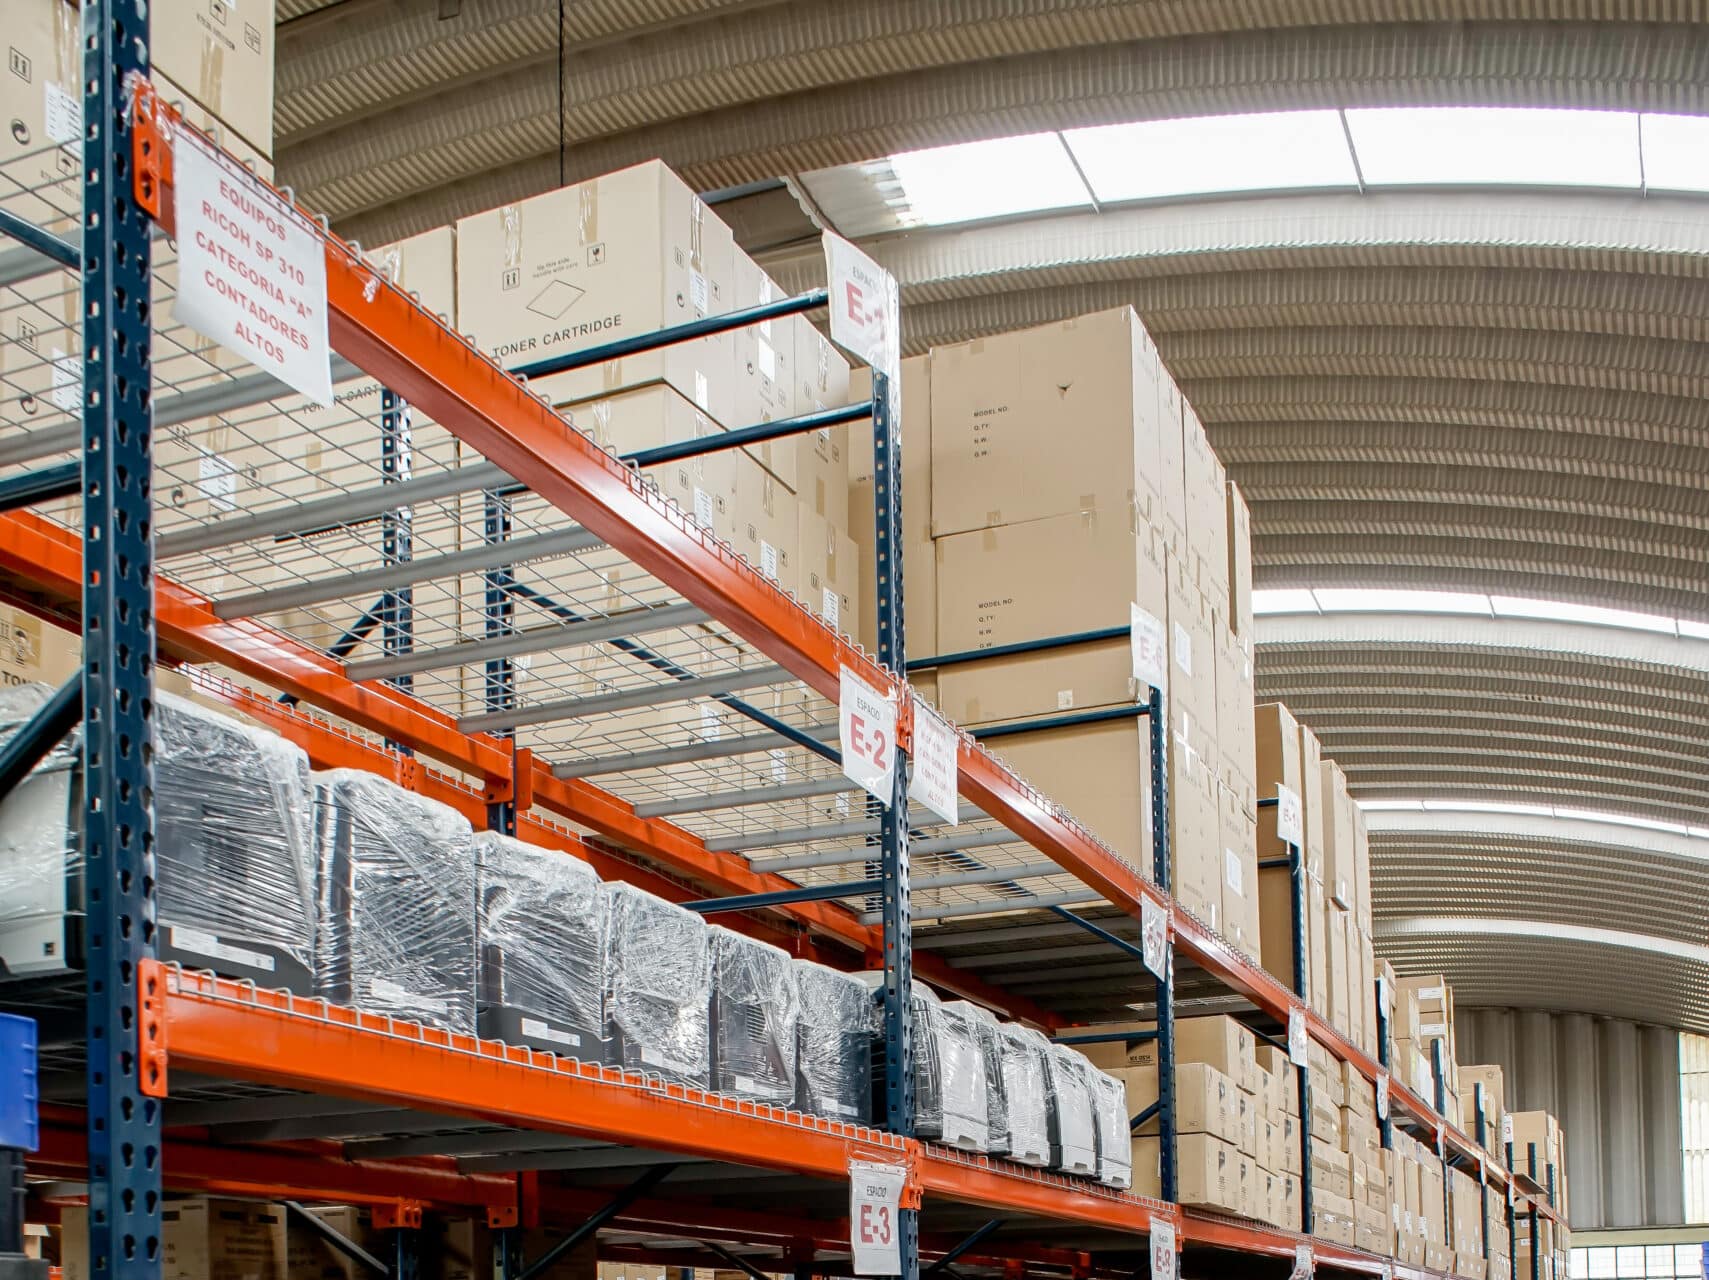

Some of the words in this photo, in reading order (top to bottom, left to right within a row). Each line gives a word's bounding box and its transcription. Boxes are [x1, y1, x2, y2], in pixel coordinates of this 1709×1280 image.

[220, 180, 286, 241] EQUIPOS
[202, 200, 251, 249] RICOH
[256, 238, 273, 263] SP
[279, 257, 305, 286] 310
[196, 231, 285, 306] CATEGORIA
[205, 270, 309, 351] CONTADORES
[236, 321, 285, 364] ALTOS
[493, 338, 537, 359] TONER
[543, 314, 623, 346] CARTRIDGE
[973, 408, 995, 417] MODEL
[978, 600, 1000, 609] MODEL
[856, 697, 881, 721] ESPACIO
[851, 713, 886, 770] E-2
[866, 1185, 887, 1198] ESPACIO
[860, 1204, 891, 1245] E-3
